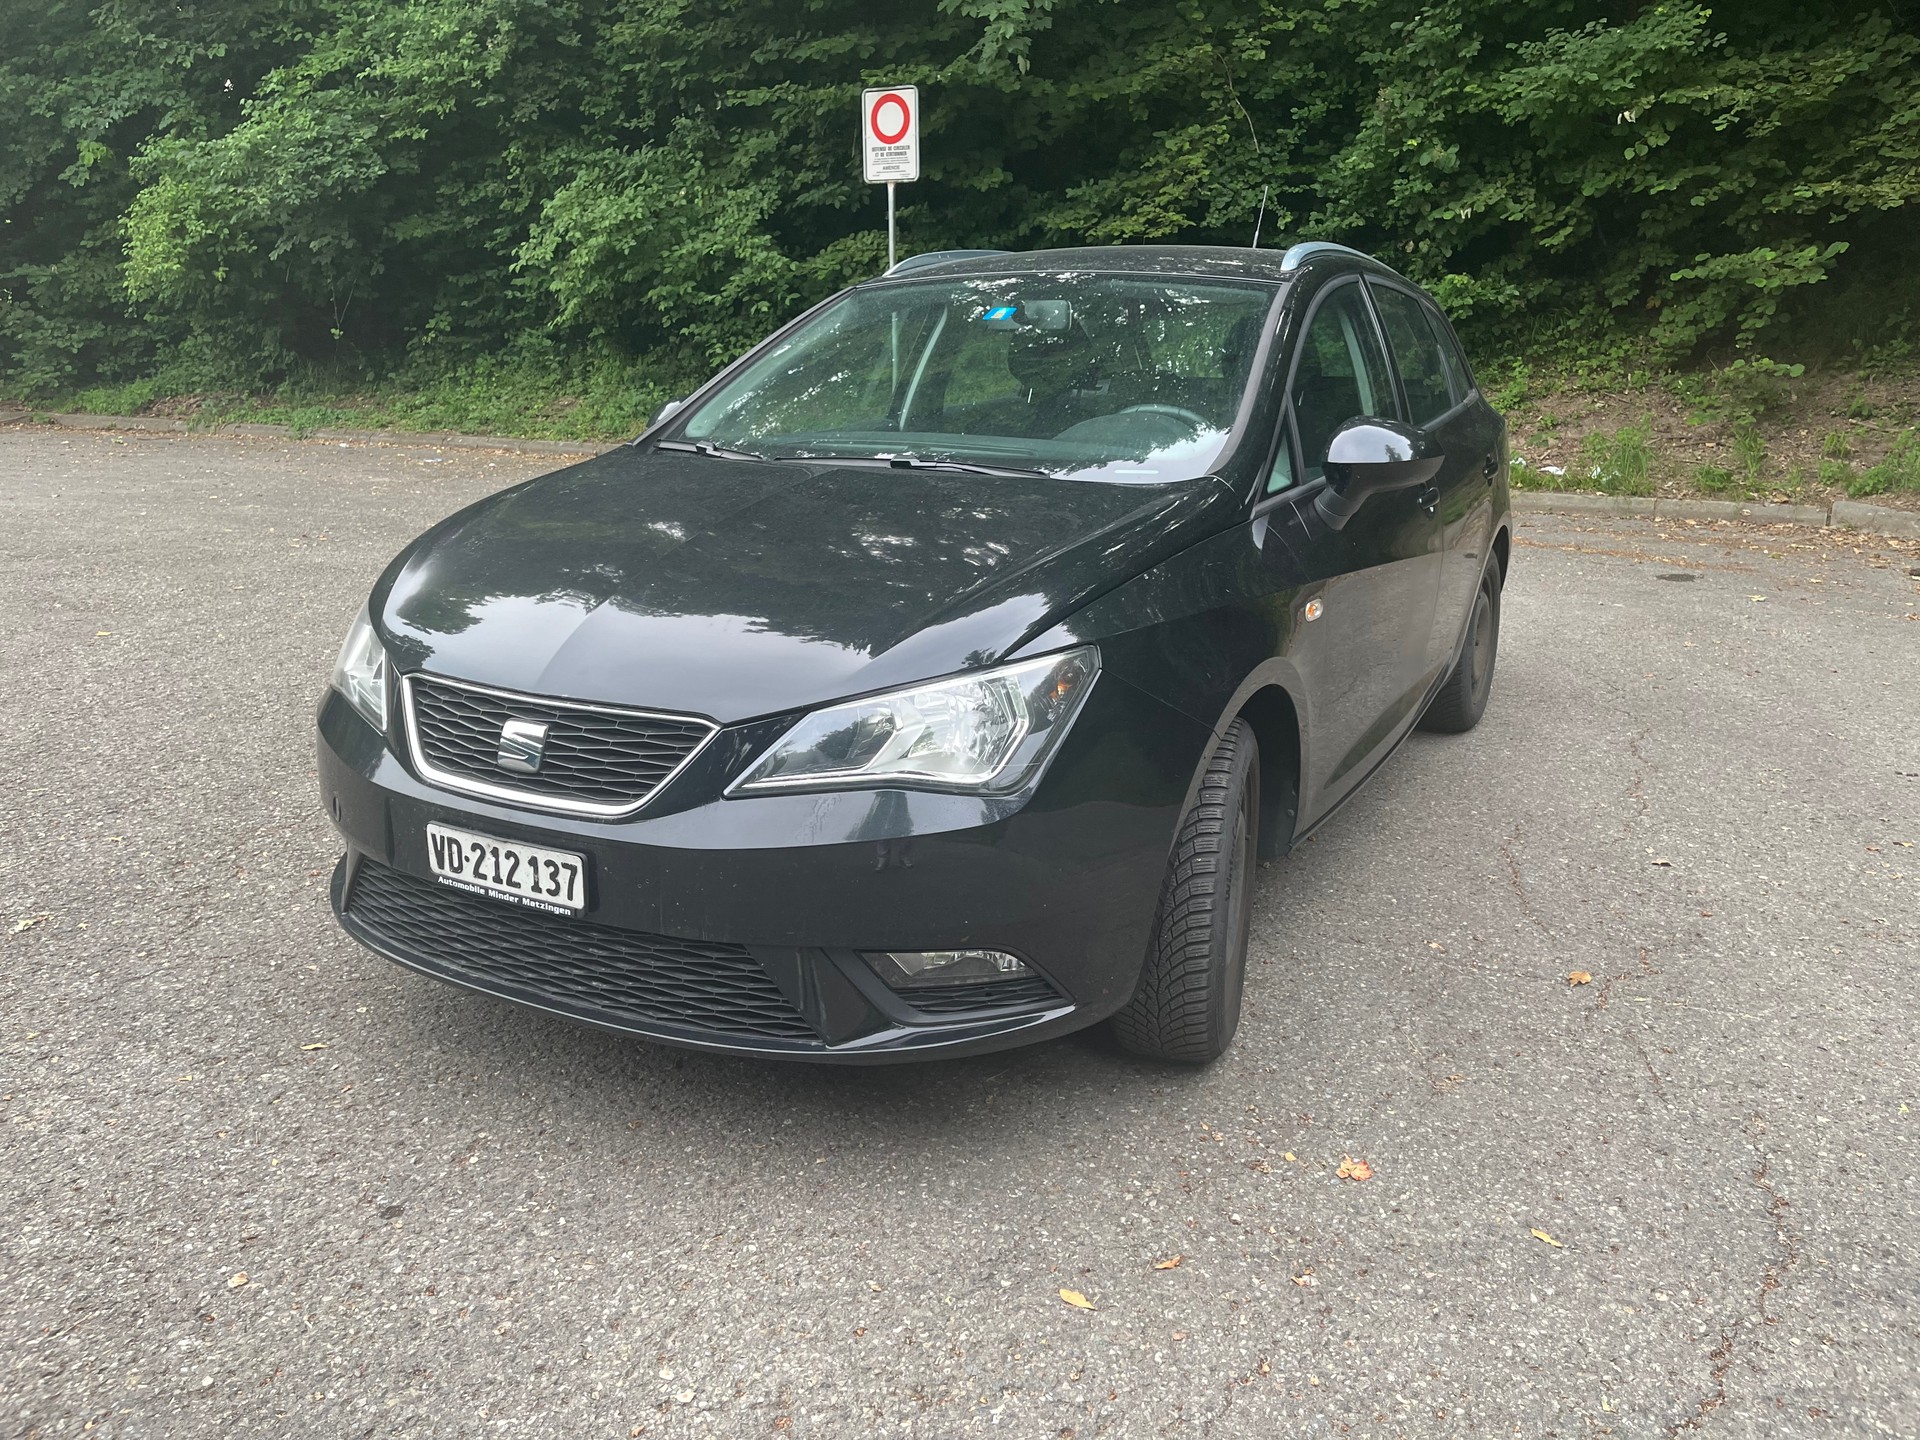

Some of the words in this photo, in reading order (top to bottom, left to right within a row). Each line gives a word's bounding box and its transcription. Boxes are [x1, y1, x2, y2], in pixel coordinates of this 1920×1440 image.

[438, 875, 486, 895] Automobile
[488, 888, 519, 904] Minder
[522, 897, 571, 916] Matzingen
[527, 855, 578, 902] 137
